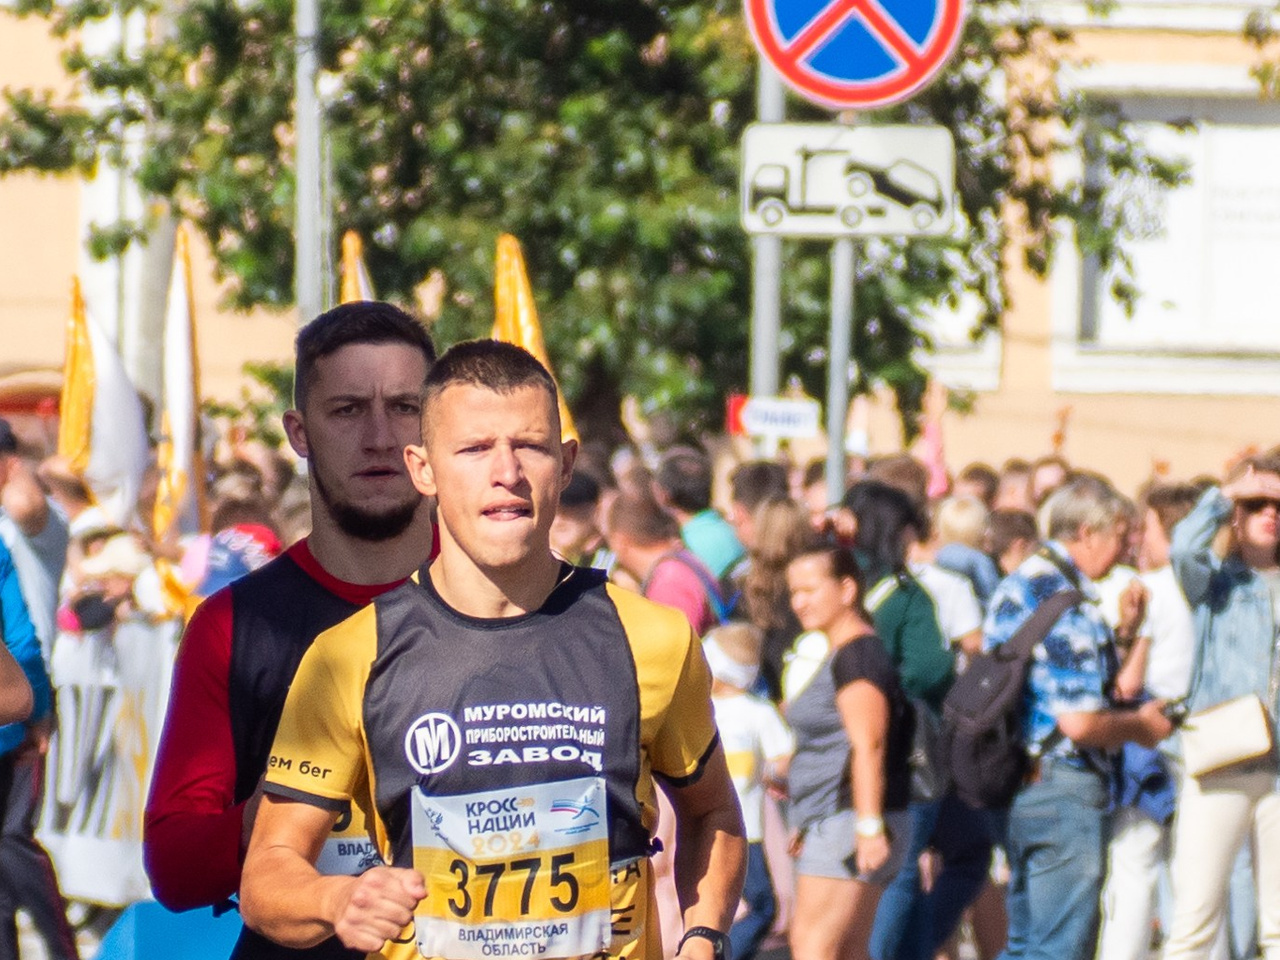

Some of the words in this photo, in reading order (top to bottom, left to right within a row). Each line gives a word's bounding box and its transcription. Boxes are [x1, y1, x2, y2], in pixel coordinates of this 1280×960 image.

[464, 703, 606, 724] МУРОМСКИЙ
[466, 724, 605, 746] ПРИБОРОСТРОИТЕЛНЫЙ
[468, 746, 603, 772] ЗАВОД
[299, 761, 332, 779] бег
[466, 797, 518, 818] КРОСС
[468, 812, 536, 835] НАЦИИ
[471, 829, 541, 856] 2024
[448, 852, 579, 918] 3775
[458, 923, 568, 943] ВЛАДИМИРСКАЯ
[482, 942, 546, 957] ОБЛАСТЬ
